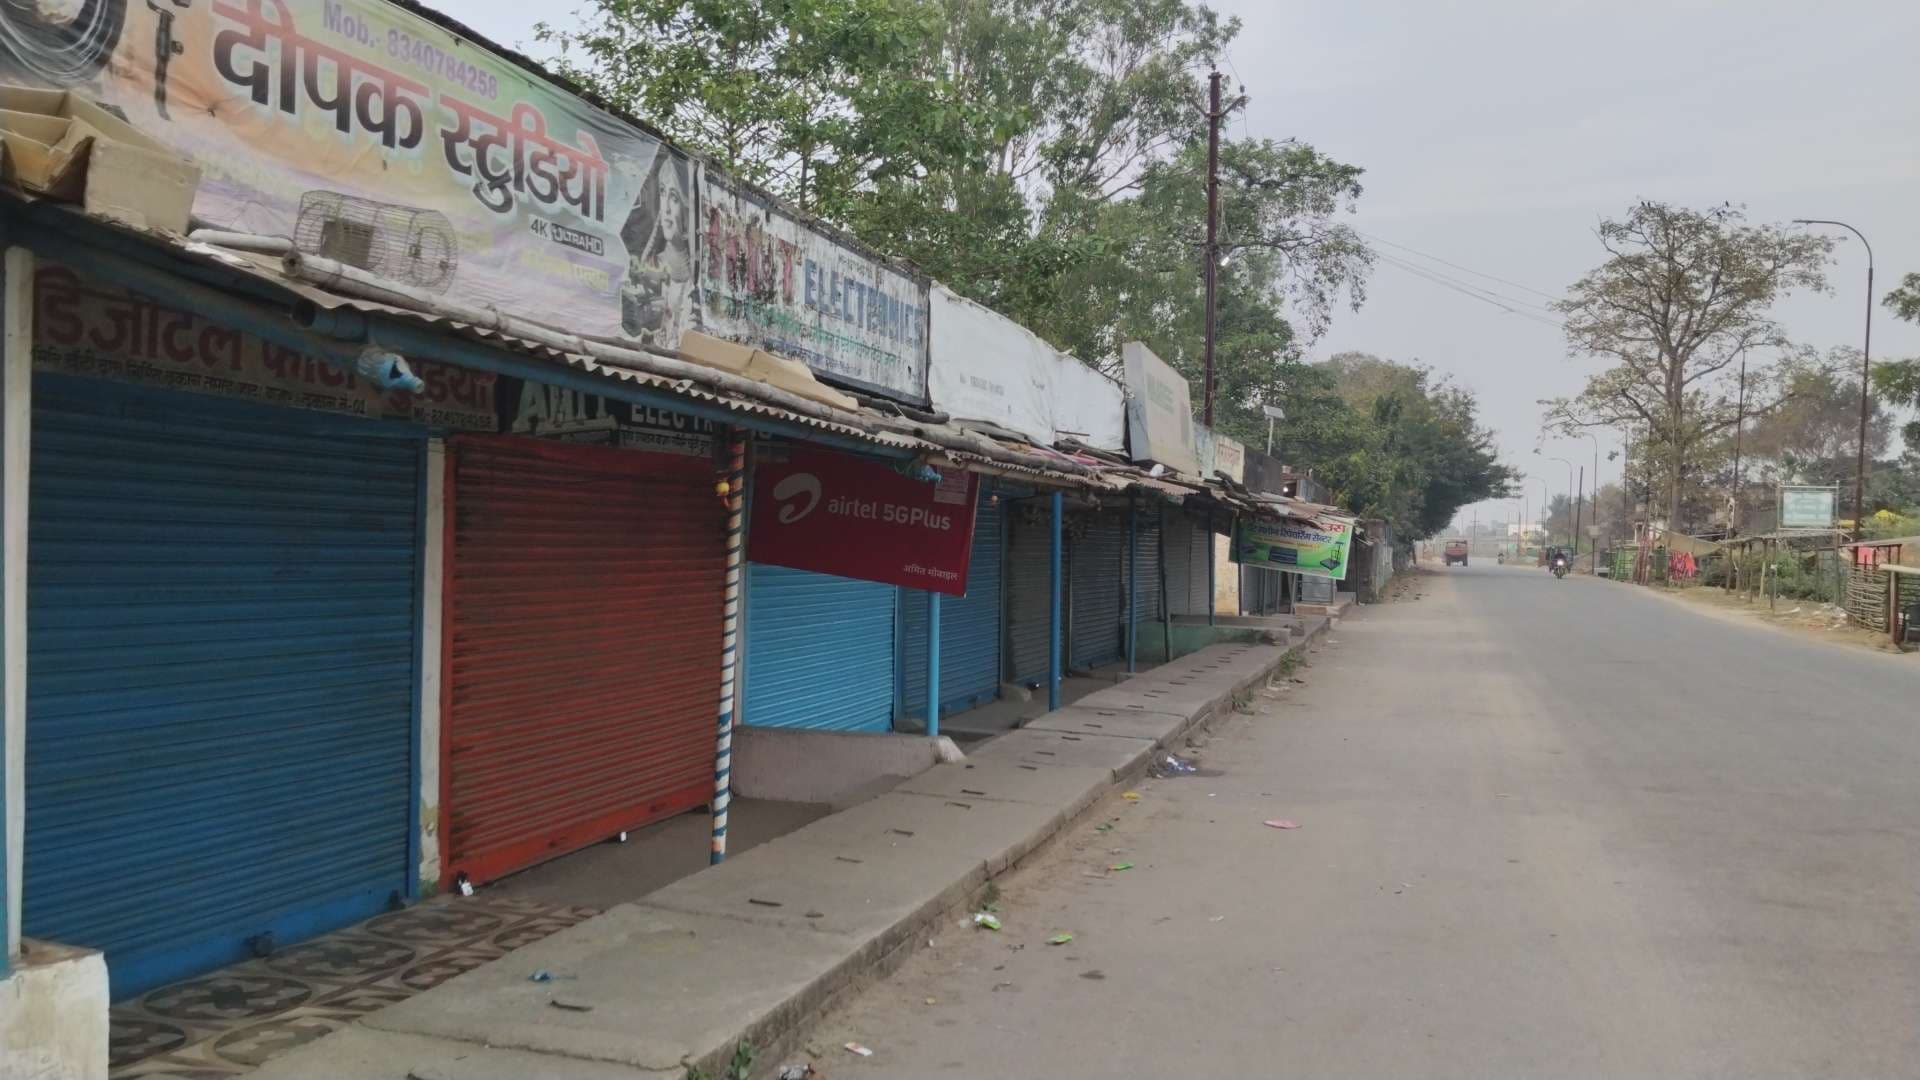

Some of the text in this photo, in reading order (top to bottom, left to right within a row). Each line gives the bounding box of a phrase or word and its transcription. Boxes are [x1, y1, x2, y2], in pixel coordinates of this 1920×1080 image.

[212, 0, 430, 150] दीपक
[386, 28, 498, 99] 8340784258
[440, 94, 609, 222] स्टुडियो
[531, 219, 548, 238] 4K
[827, 496, 878, 520] airtel
